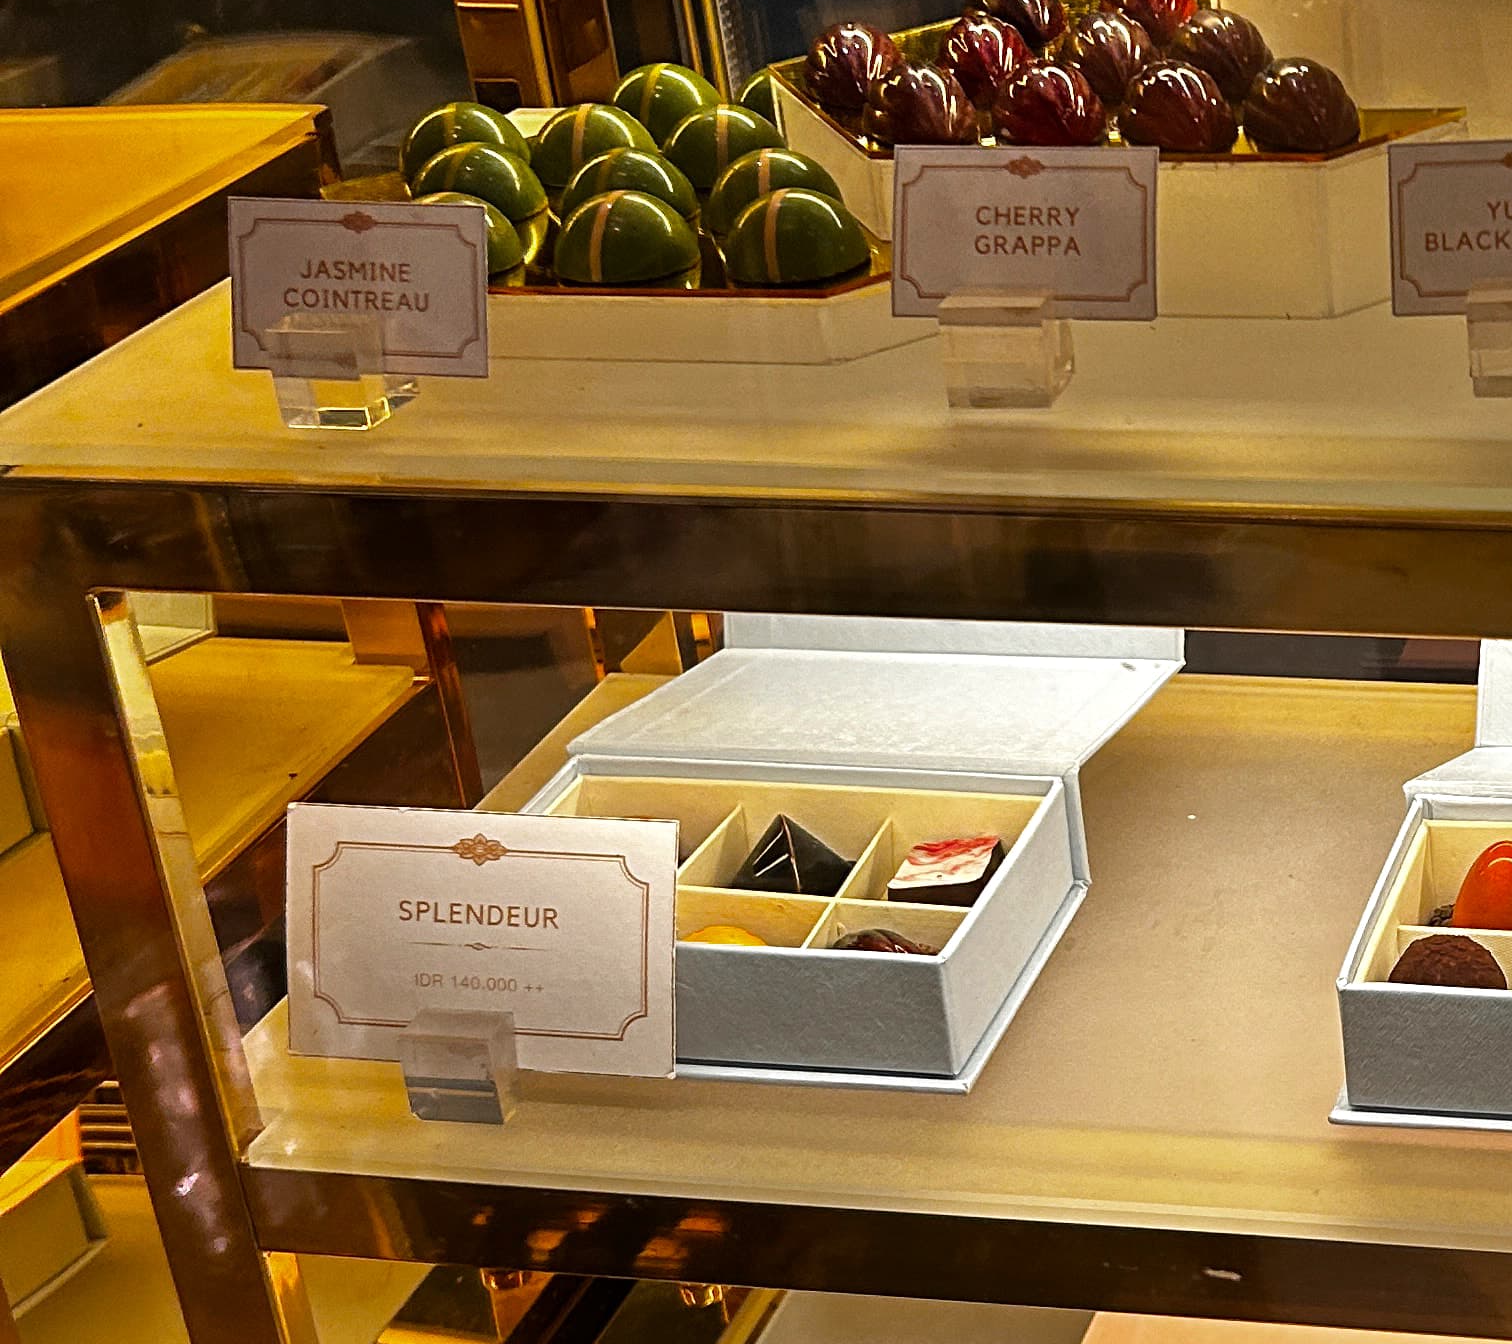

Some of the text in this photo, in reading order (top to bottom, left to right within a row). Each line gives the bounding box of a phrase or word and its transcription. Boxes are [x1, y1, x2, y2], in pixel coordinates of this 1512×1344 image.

[975, 206, 1080, 227] CHERRY
[974, 234, 1081, 256] GRAPPA
[1424, 230, 1511, 252] BLACK
[300, 259, 411, 283] JASMINE
[283, 287, 430, 313] COINTREAU
[399, 900, 559, 929] SPLENDEUR
[414, 972, 443, 988] IDR
[450, 975, 518, 993] 140.000
